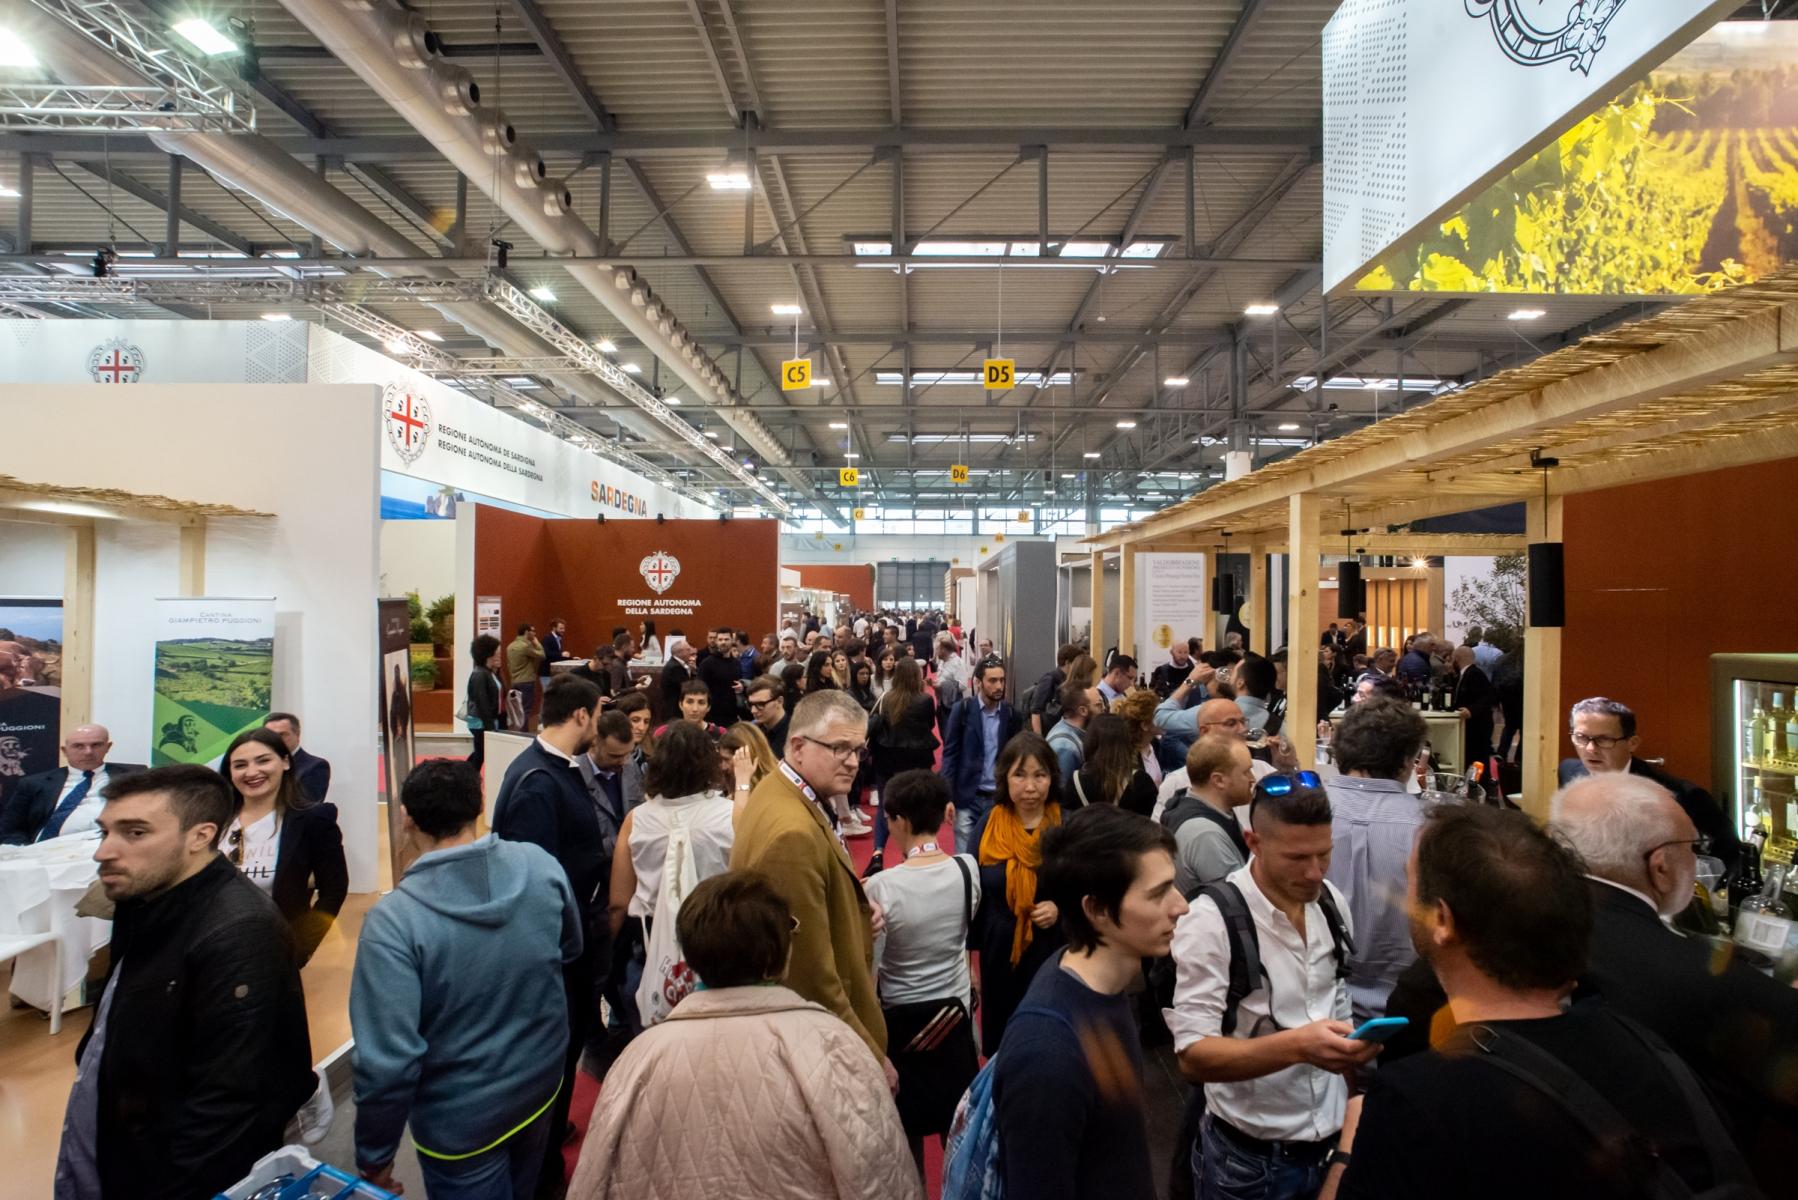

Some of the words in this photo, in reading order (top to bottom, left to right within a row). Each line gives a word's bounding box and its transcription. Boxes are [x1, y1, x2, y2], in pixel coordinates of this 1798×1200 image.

[787, 366, 806, 383] C5
[988, 366, 1009, 383] D5
[438, 423, 467, 442] REGIONE
[468, 435, 502, 454] AUTONOMA
[503, 448, 510, 458] DE
[511, 451, 536, 467] SARDIGNA
[438, 439, 467, 457] REGIONE
[468, 450, 502, 468] AUTONOMA
[503, 462, 518, 473] DELLA
[518, 467, 544, 482] SARDEGNA
[843, 472, 855, 482] C6
[953, 469, 965, 479] D6
[591, 480, 647, 517] SARDEGNA
[617, 599, 652, 607] REGIONE
[653, 599, 702, 607] AUTONOMA
[625, 607, 648, 615] DELLA
[650, 607, 693, 615] SARDEGNA
